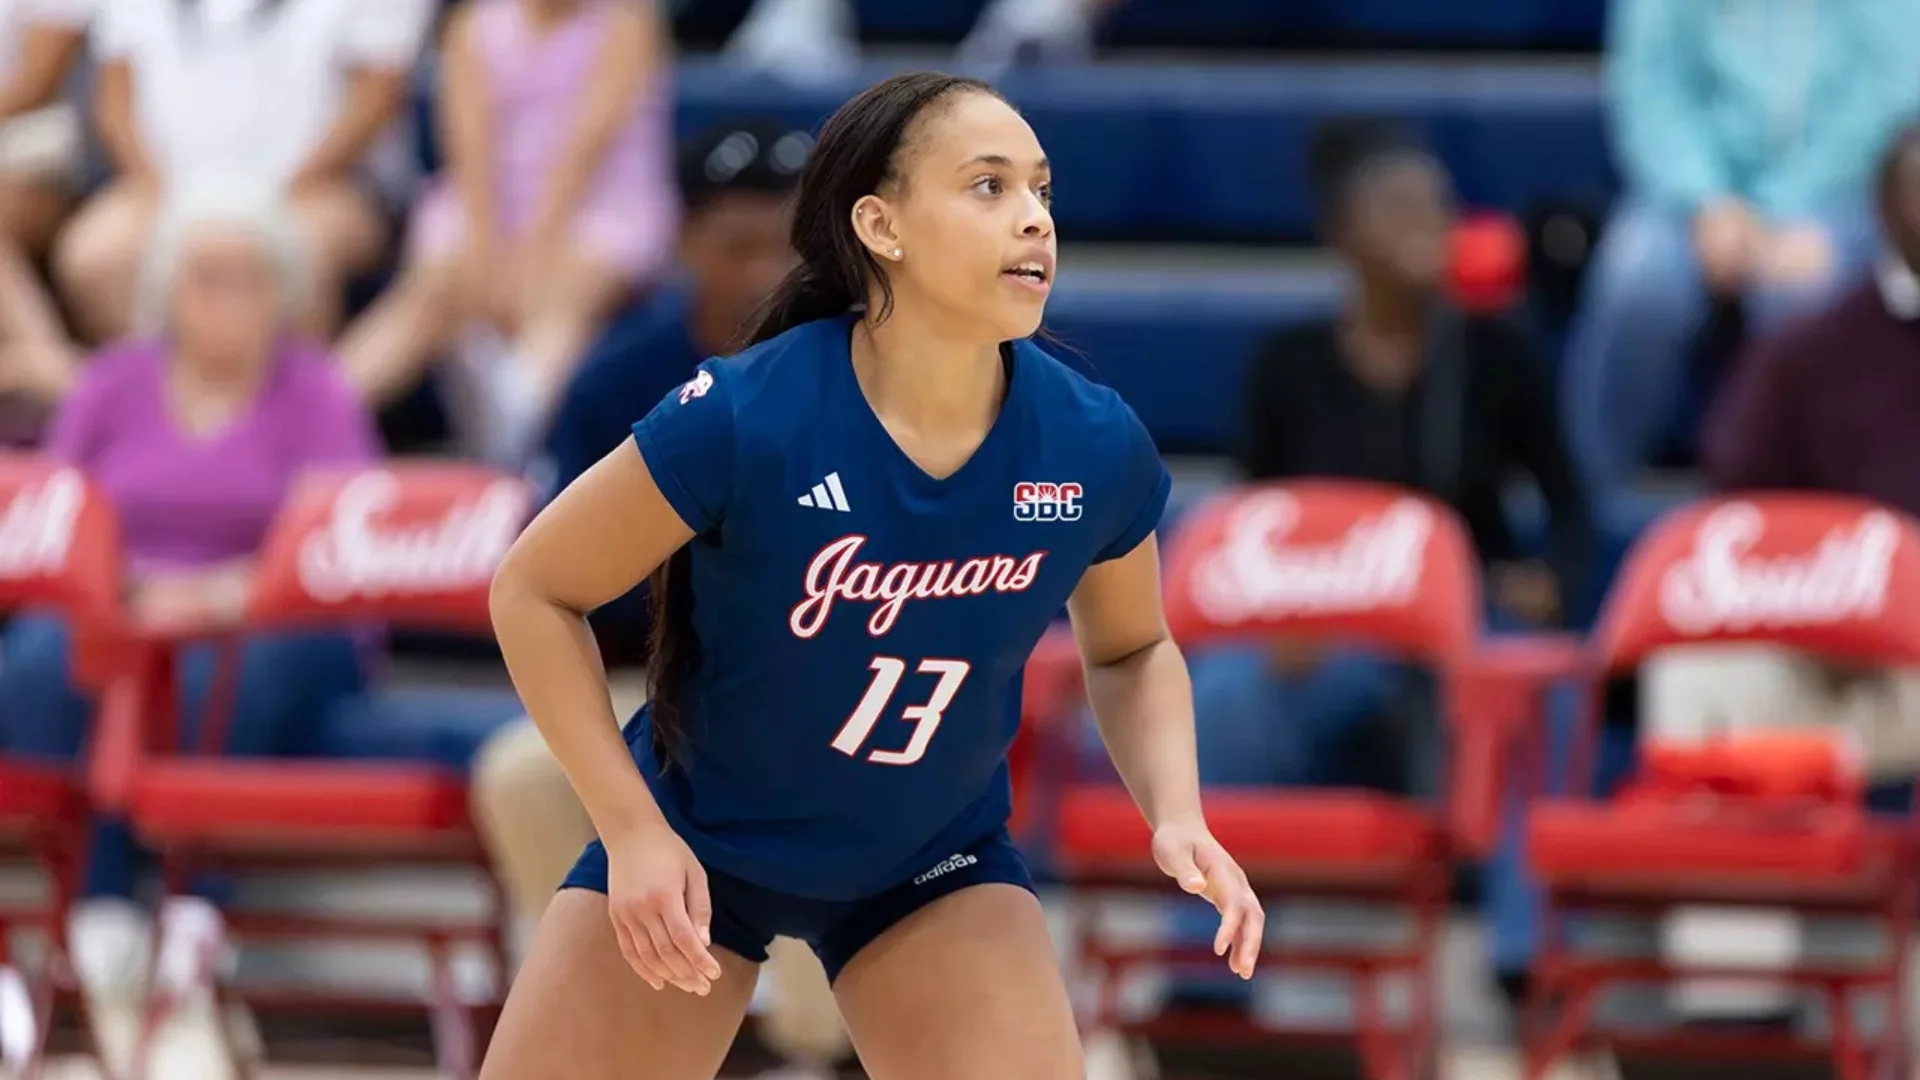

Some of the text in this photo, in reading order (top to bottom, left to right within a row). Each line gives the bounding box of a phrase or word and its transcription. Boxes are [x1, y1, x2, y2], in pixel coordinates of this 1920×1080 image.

[1013, 482, 1083, 521] SBC
[789, 534, 1049, 639] Jaguars
[829, 656, 972, 766] 13
[914, 854, 978, 885] adidas
